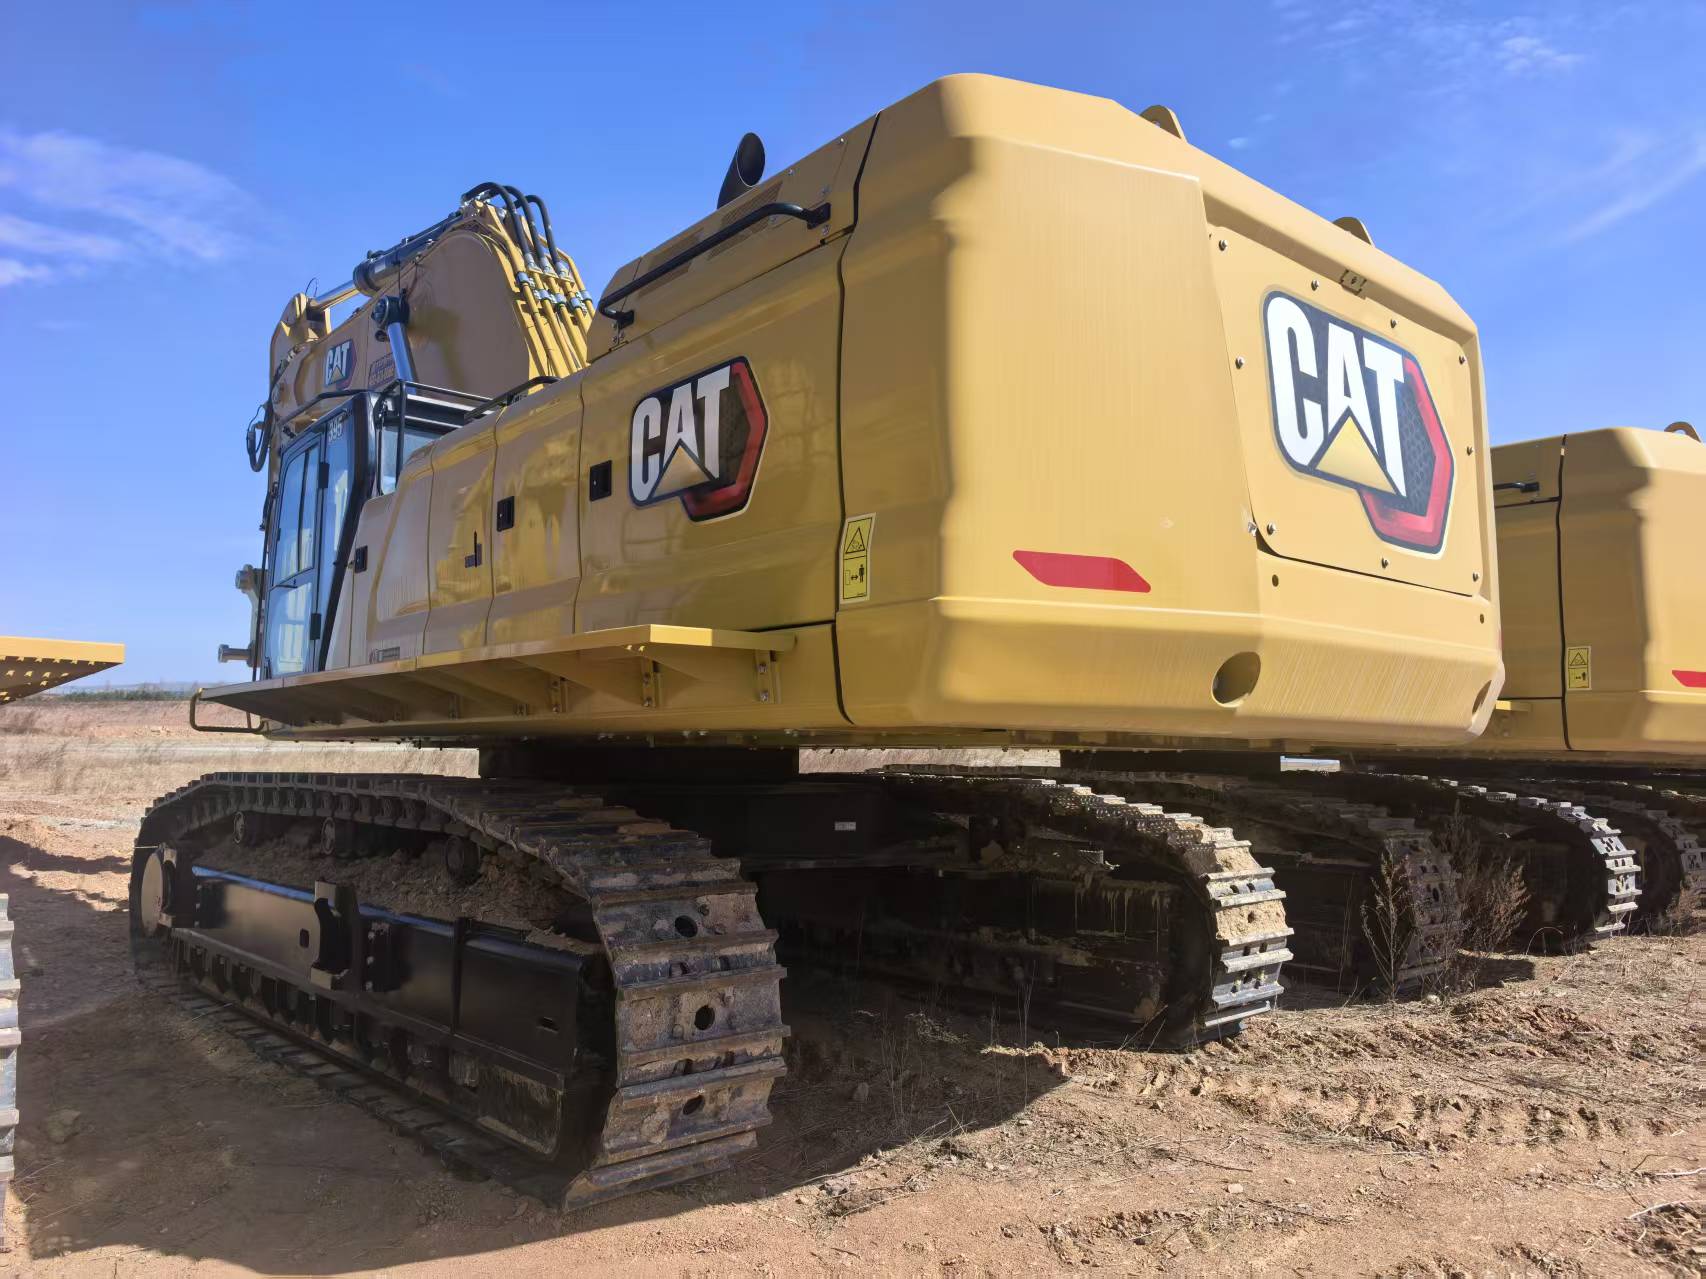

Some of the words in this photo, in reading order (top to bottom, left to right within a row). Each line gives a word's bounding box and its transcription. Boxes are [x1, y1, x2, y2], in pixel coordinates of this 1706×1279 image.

[325, 341, 350, 385] CAT
[1267, 296, 1407, 497] CAT
[631, 366, 731, 501] CAT
